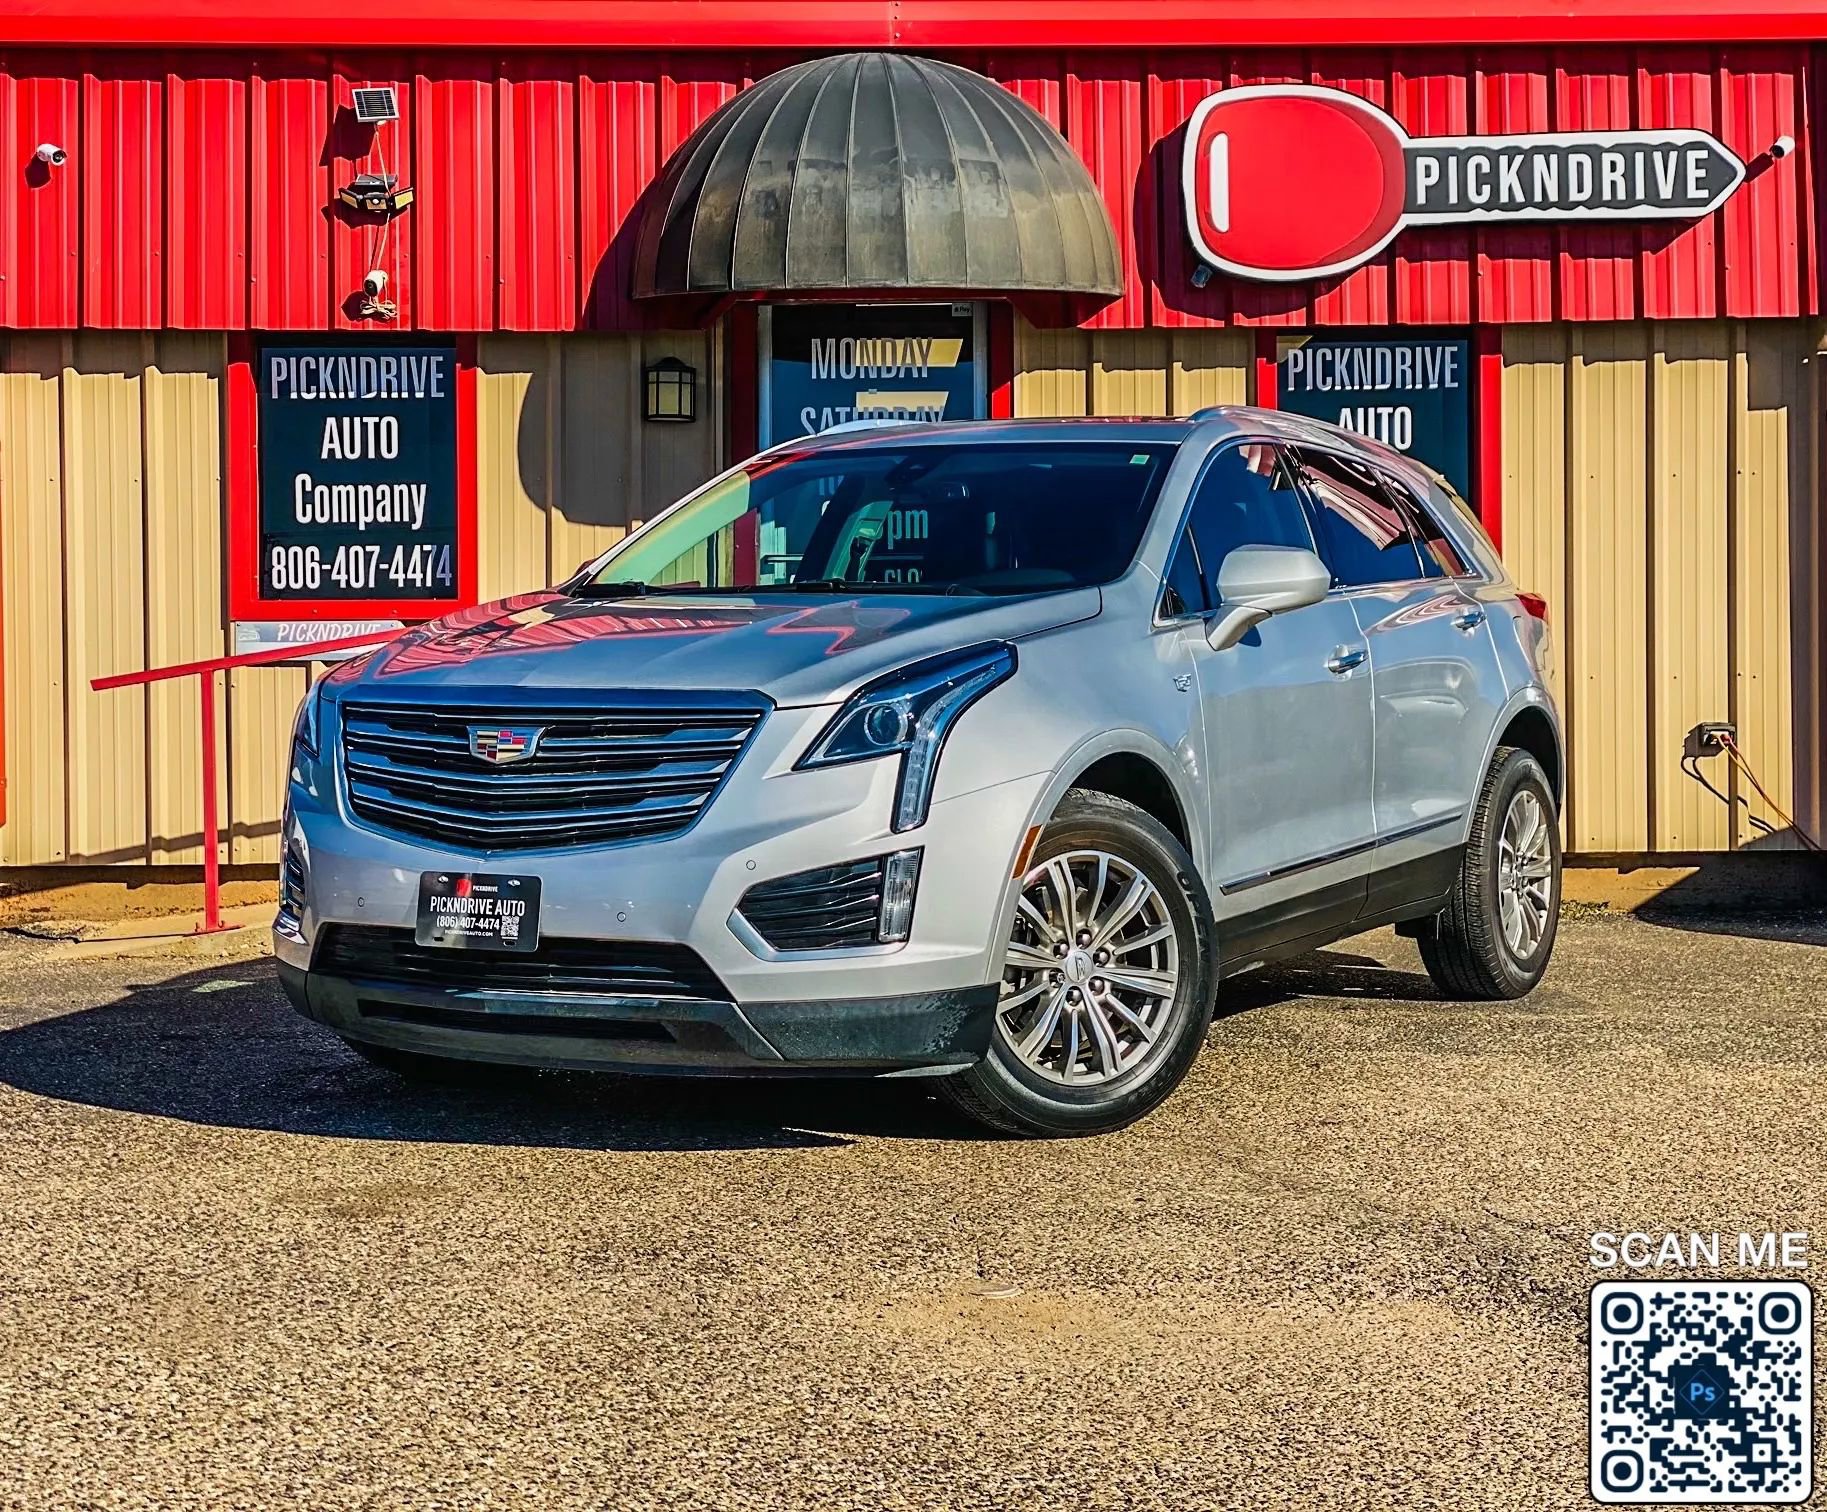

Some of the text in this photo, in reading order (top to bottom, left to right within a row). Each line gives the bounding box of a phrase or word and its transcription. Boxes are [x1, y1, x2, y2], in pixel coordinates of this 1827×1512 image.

[1415, 150, 1710, 205] PICKNDRIVE
[271, 355, 445, 399] PICKNDRIVE
[811, 337, 933, 379] MONDAY
[1287, 346, 1459, 391] PICKNDRIVE
[320, 416, 399, 460] AUTO
[294, 473, 427, 531] Company
[887, 509, 928, 549] pm
[271, 544, 452, 589] 806-407-4474
[430, 896, 525, 916] PICKNDRIVE AUTO
[437, 915, 500, 930] (806) 407-4474
